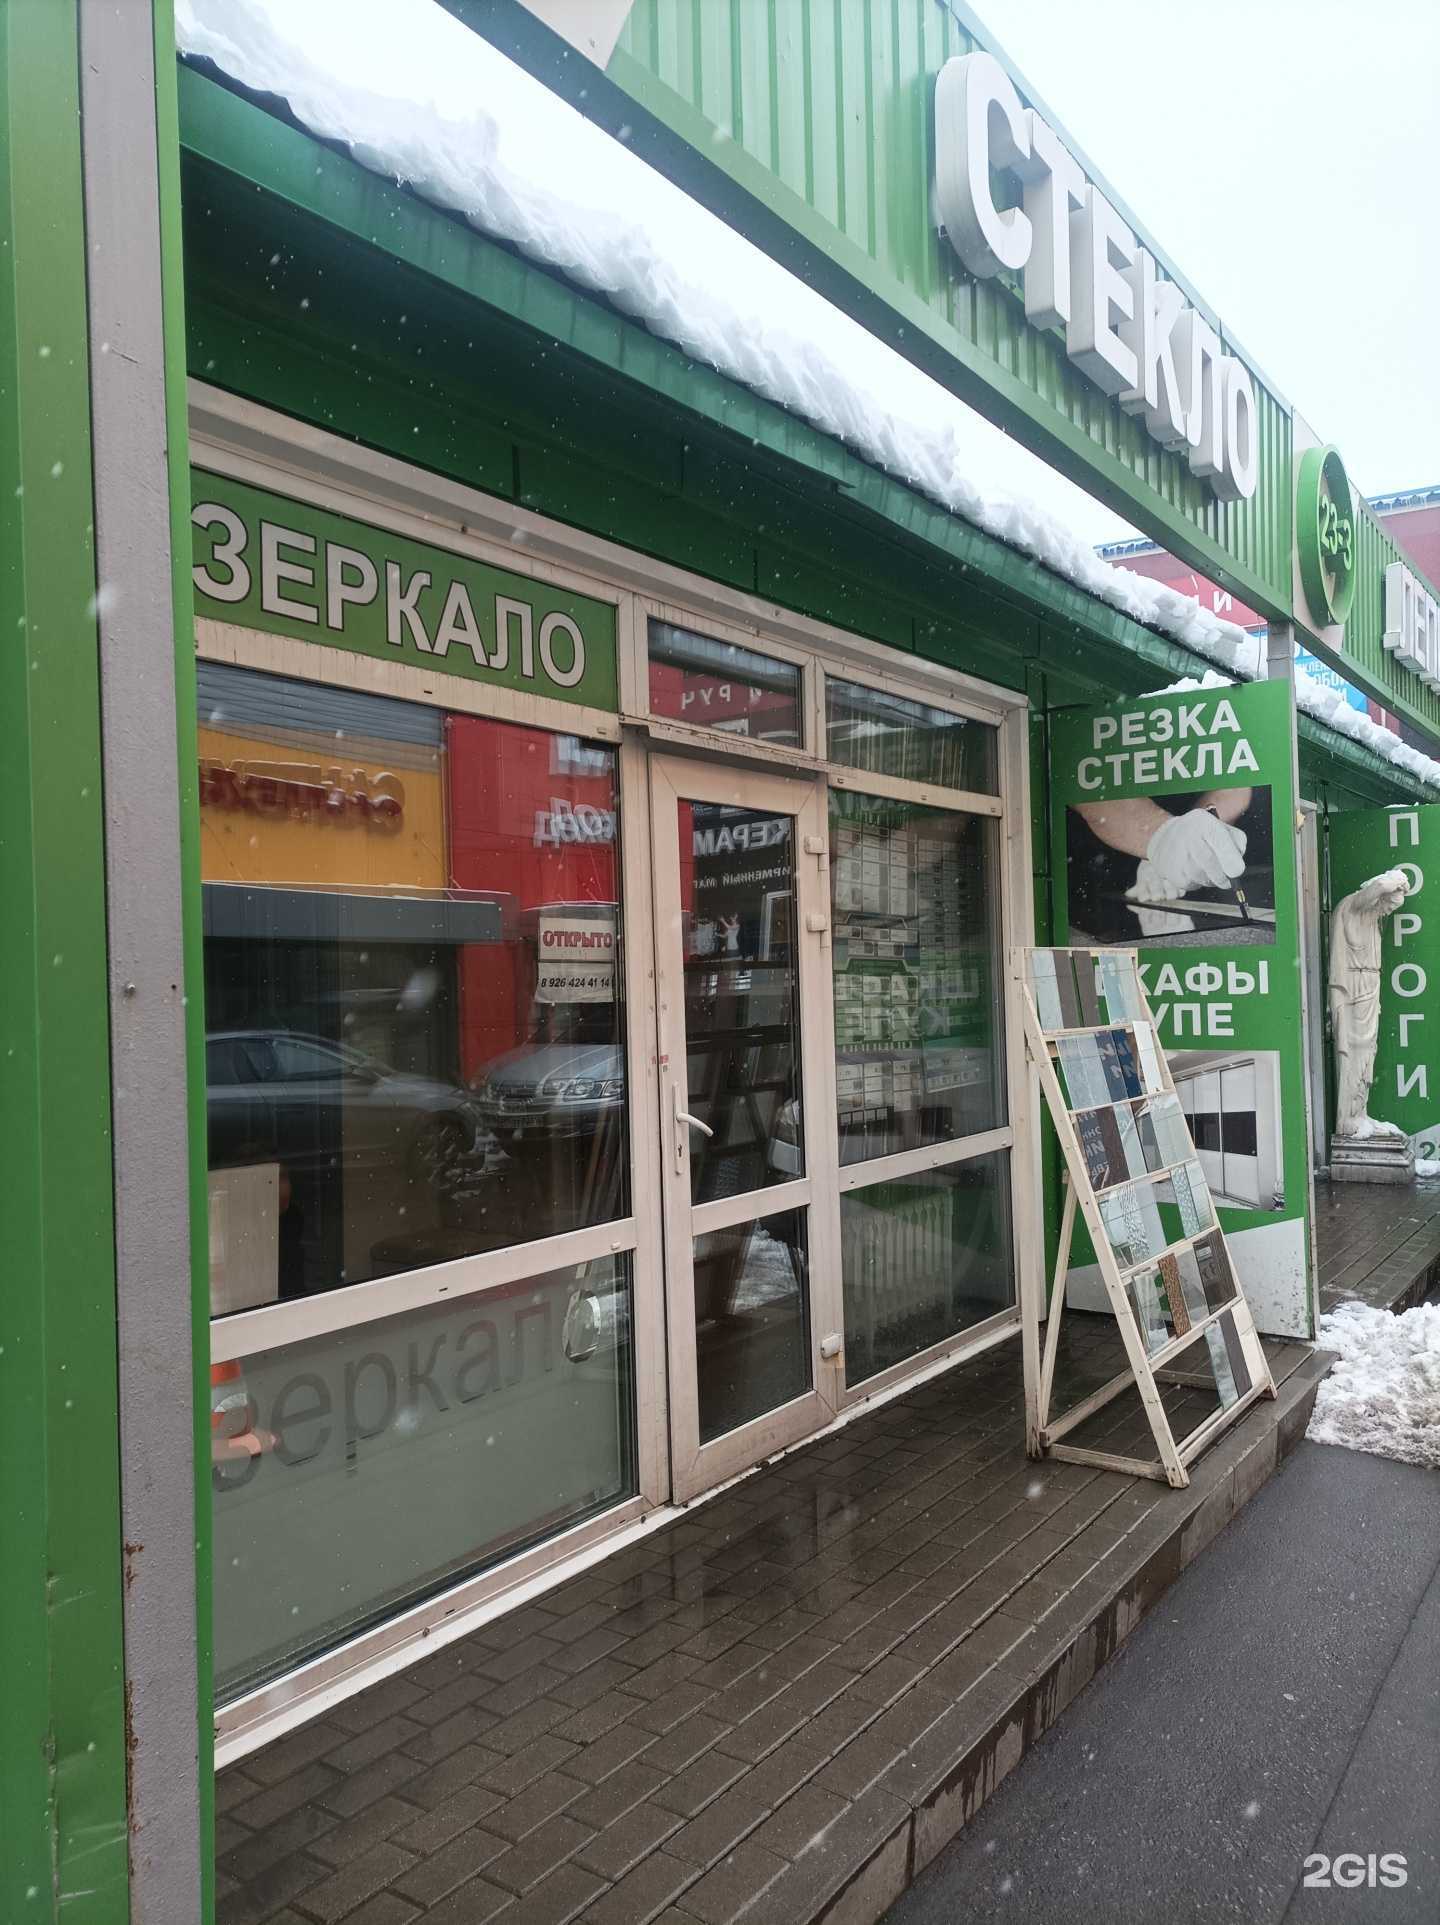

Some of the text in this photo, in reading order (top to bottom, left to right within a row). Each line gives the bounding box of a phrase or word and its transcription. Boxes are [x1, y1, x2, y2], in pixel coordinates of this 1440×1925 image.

[935, 51, 1257, 501] СТЕКЛО
[191, 501, 586, 688] ЗЕРКАЛО
[1092, 699, 1242, 750] РЕЗКА
[1077, 738, 1261, 791] СТЕКЛА
[543, 930, 612, 948] ОТКРЫТО
[541, 978, 547, 988] 8
[549, 978, 566, 988] 926
[568, 978, 585, 988] 424
[588, 978, 598, 988] 41
[1149, 1002, 1235, 1036] УПЕ
